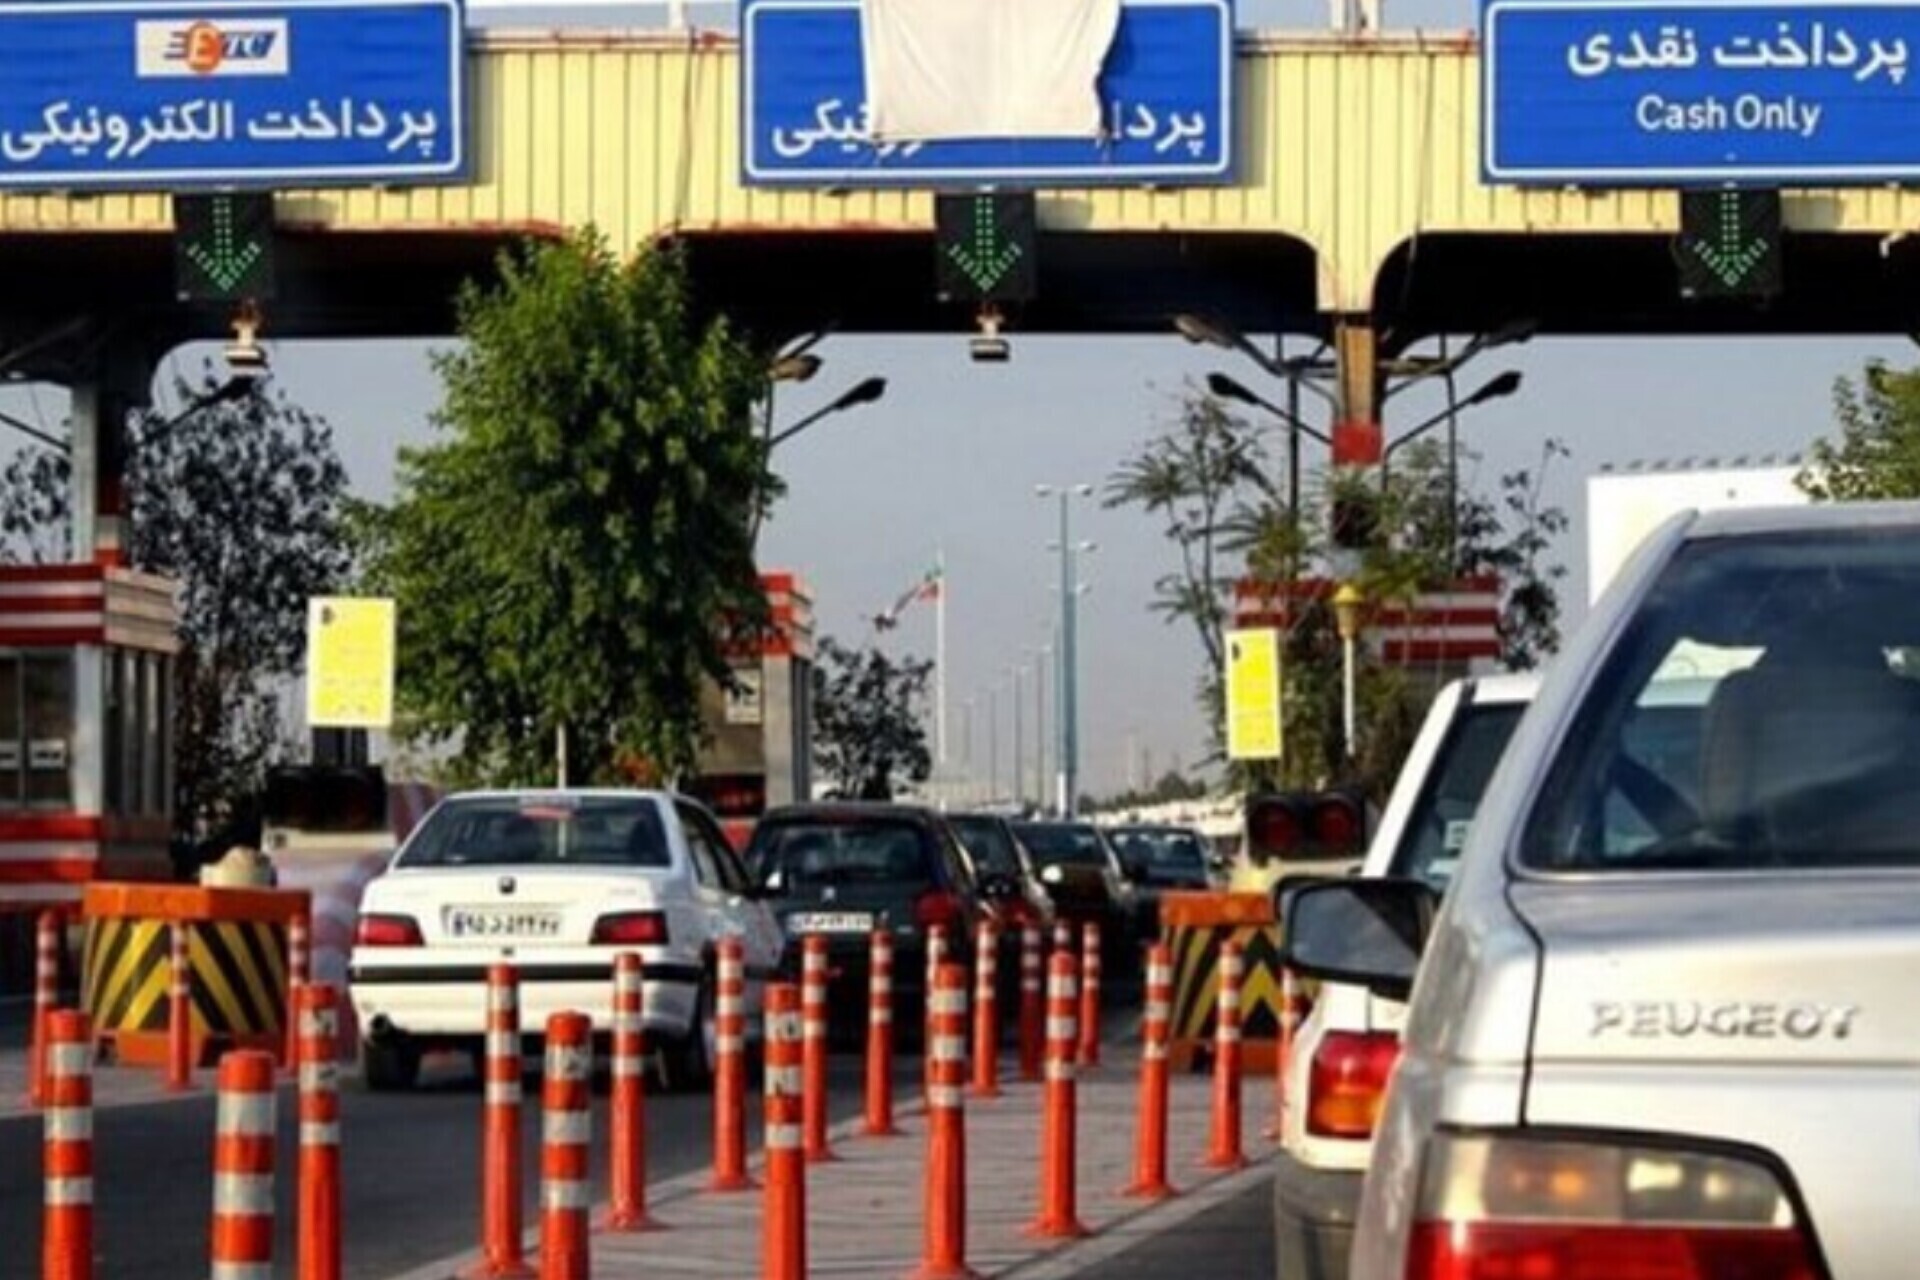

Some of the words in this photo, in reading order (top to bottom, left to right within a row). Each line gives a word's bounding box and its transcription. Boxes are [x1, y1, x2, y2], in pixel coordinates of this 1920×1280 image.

[1568, 26, 1698, 76] نقدی
[1713, 23, 1907, 84] پرداخت
[2, 99, 234, 160] الکترونیکی
[247, 99, 437, 156] پرداخت
[1636, 94, 1727, 131] Cash
[1734, 94, 1821, 136] Only
[1588, 1002, 1862, 1040] PEUGEOT
